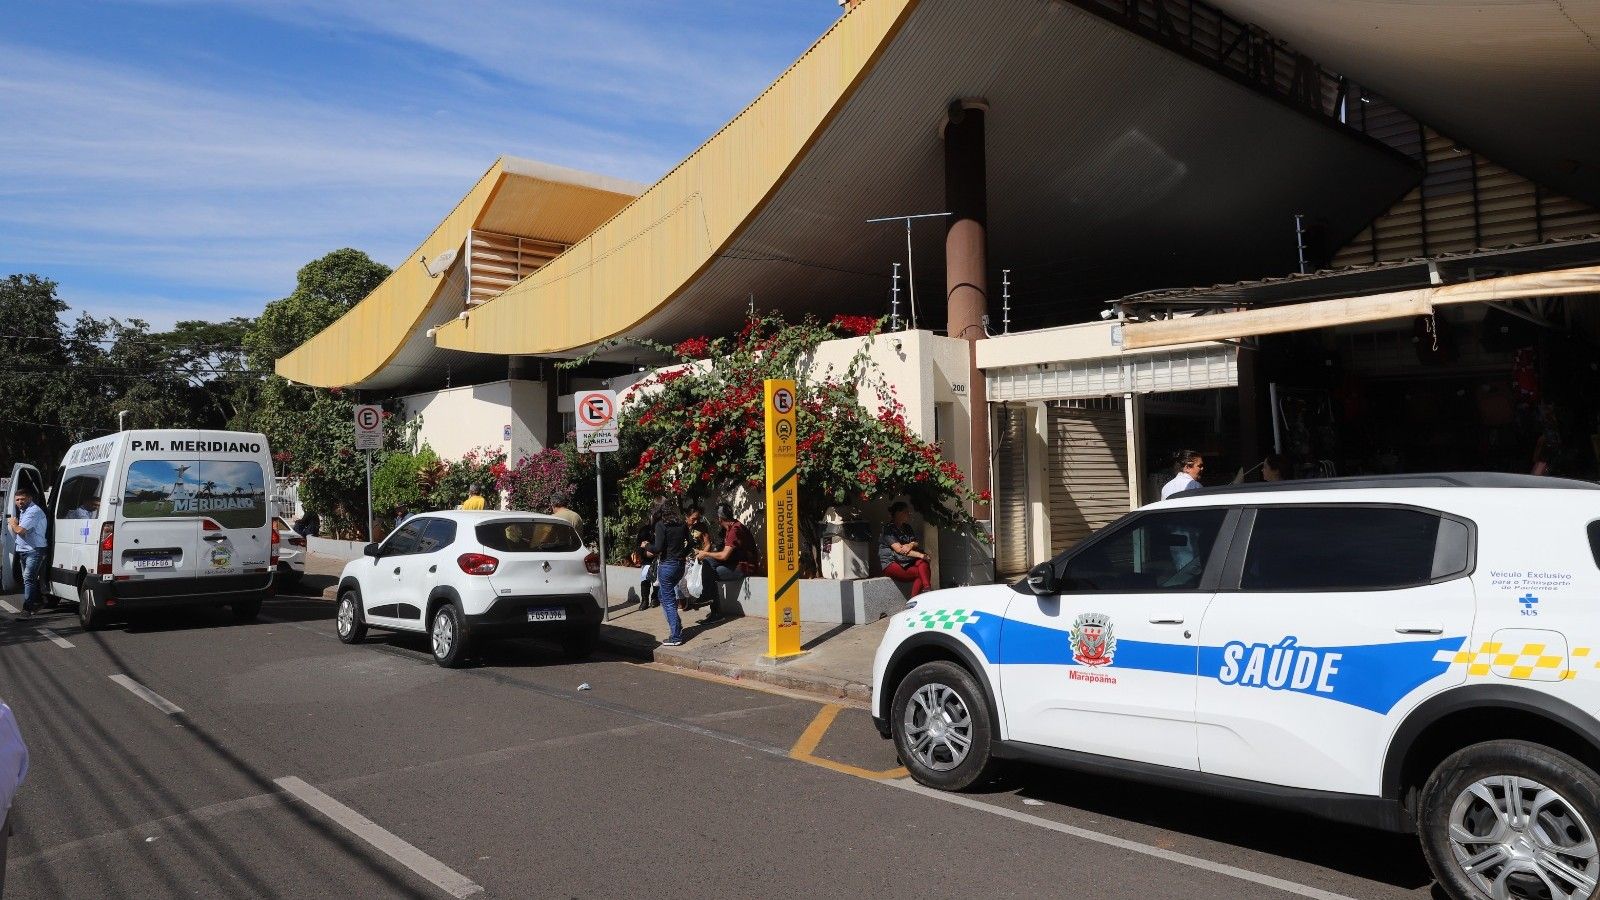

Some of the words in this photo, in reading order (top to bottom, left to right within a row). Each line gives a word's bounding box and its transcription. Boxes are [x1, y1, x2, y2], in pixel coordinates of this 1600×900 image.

[952, 384, 965, 392] 200
[779, 393, 788, 409] E
[588, 399, 604, 420] E
[363, 412, 373, 426] E
[131, 440, 164, 451] P.M.
[170, 440, 261, 453] MERIDIANO
[173, 498, 255, 513] MERIDIANO
[778, 500, 786, 562] EMBARQUE
[786, 488, 795, 572] DESEMBARQUE
[1527, 571, 1572, 579] Exclusivo
[1520, 609, 1538, 617] SUS
[1219, 638, 1343, 693] SAÚDE
[1069, 670, 1117, 685] Marapoama
